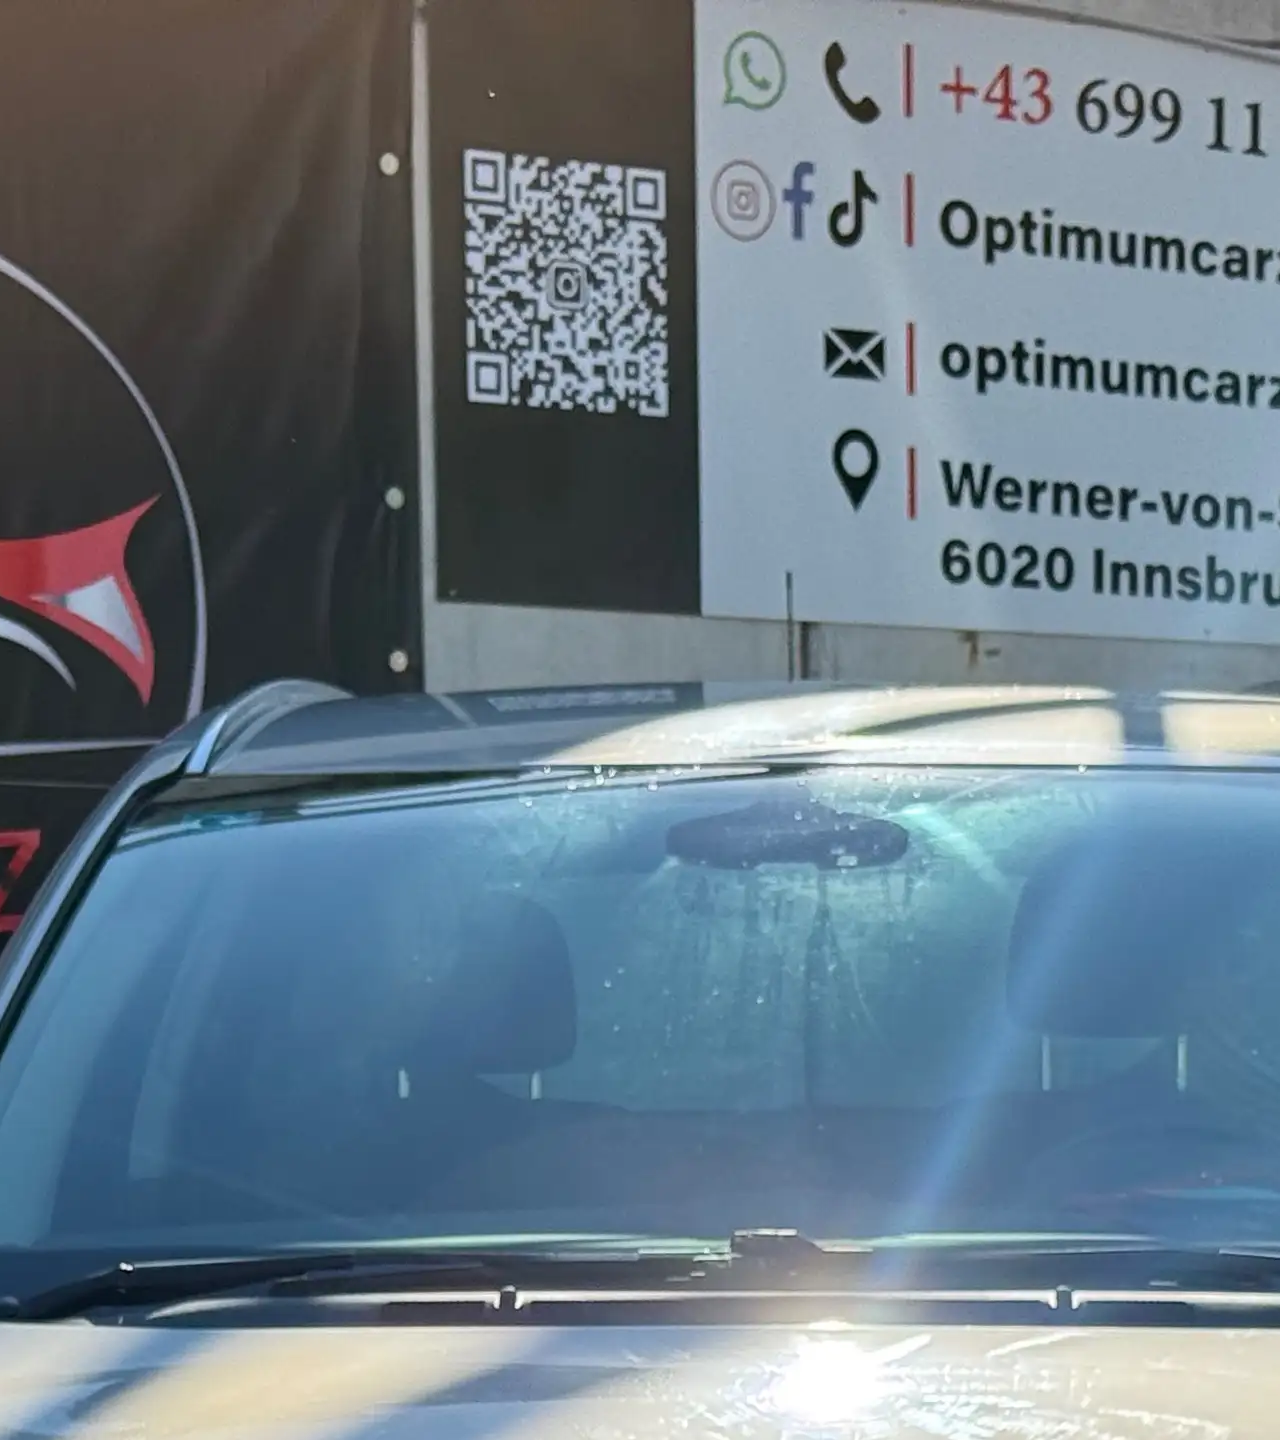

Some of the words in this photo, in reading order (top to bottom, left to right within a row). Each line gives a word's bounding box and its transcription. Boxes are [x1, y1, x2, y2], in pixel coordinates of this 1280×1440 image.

[940, 64, 1054, 126] +43
[1076, 78, 1183, 143] 699
[1206, 97, 1268, 157] 11
[941, 538, 1075, 592] 6020
